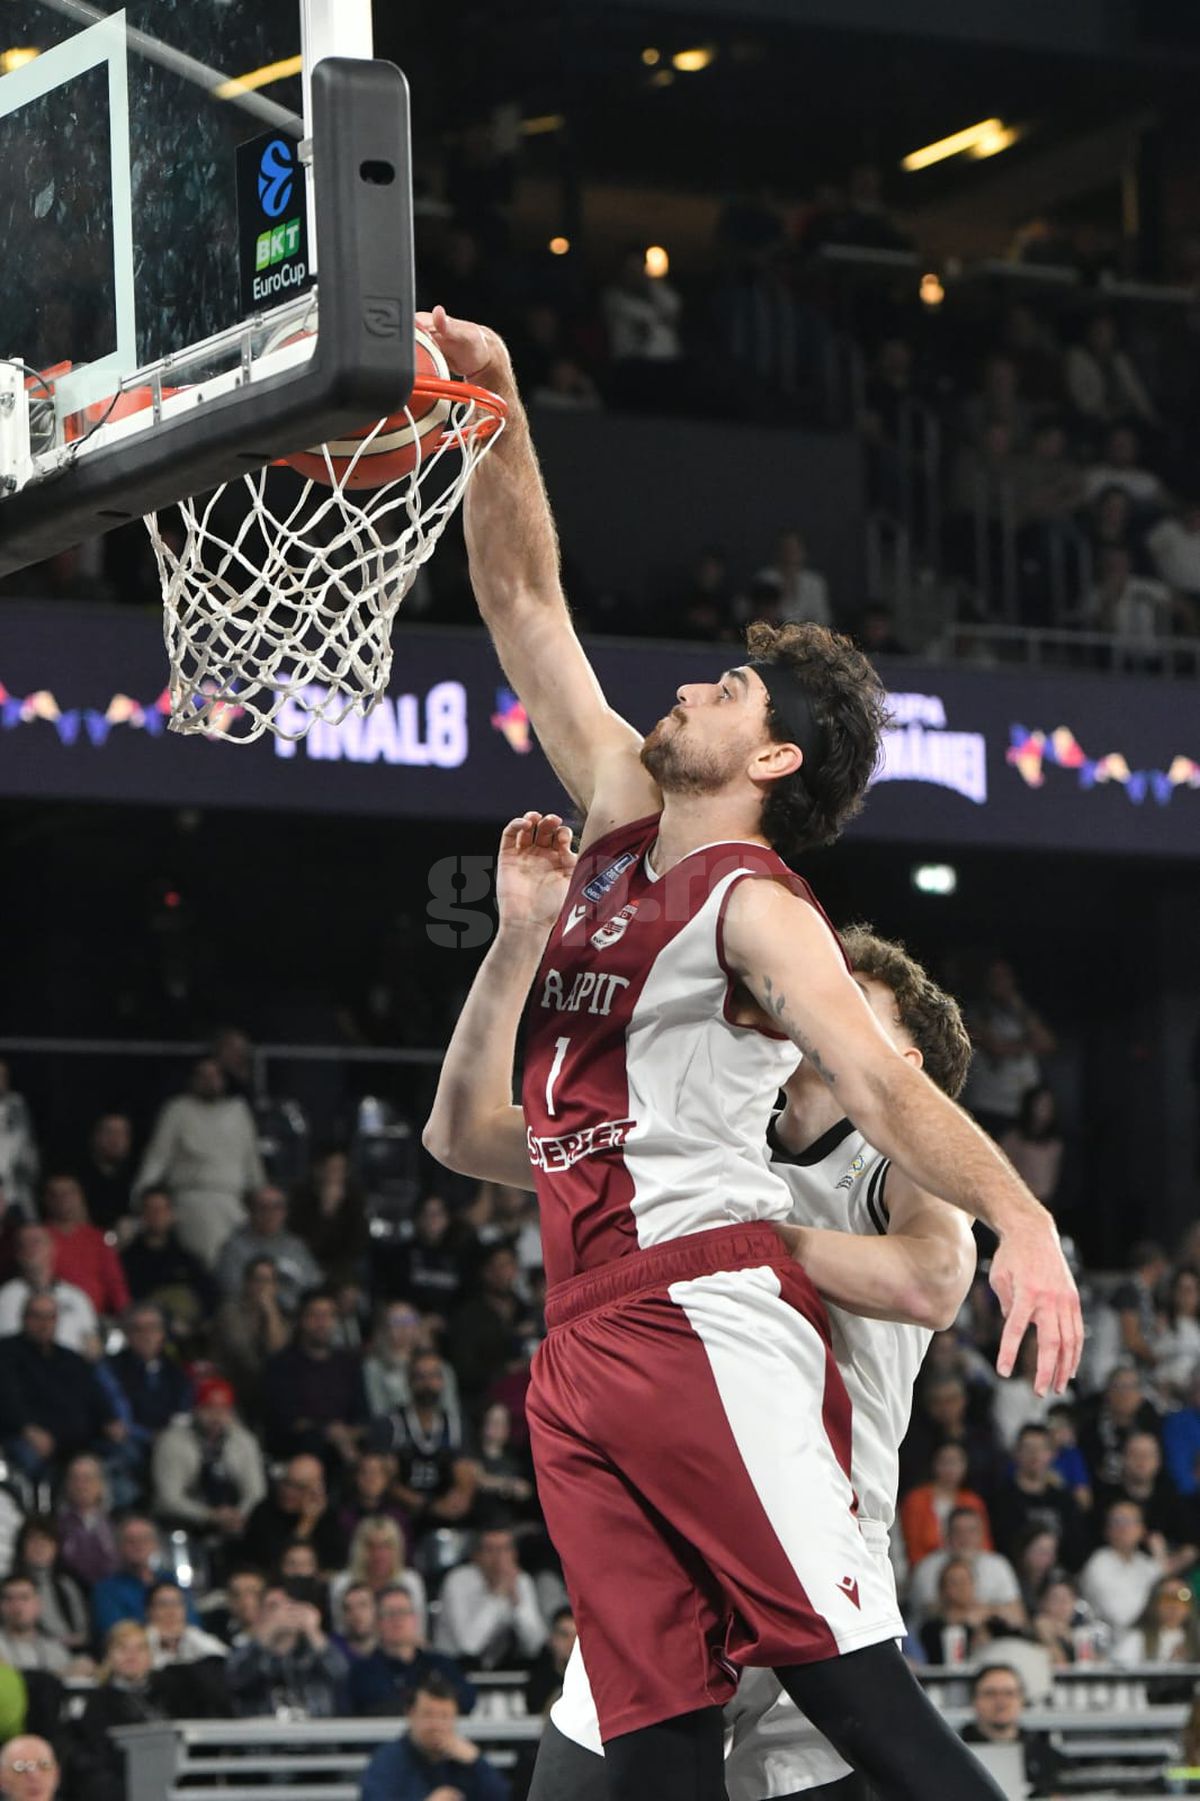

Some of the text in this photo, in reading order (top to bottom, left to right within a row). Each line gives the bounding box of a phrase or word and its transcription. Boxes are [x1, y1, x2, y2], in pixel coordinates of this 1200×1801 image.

[256, 221, 300, 268] BKT
[252, 262, 306, 301] EuroCup
[545, 1036, 571, 1116] 1
